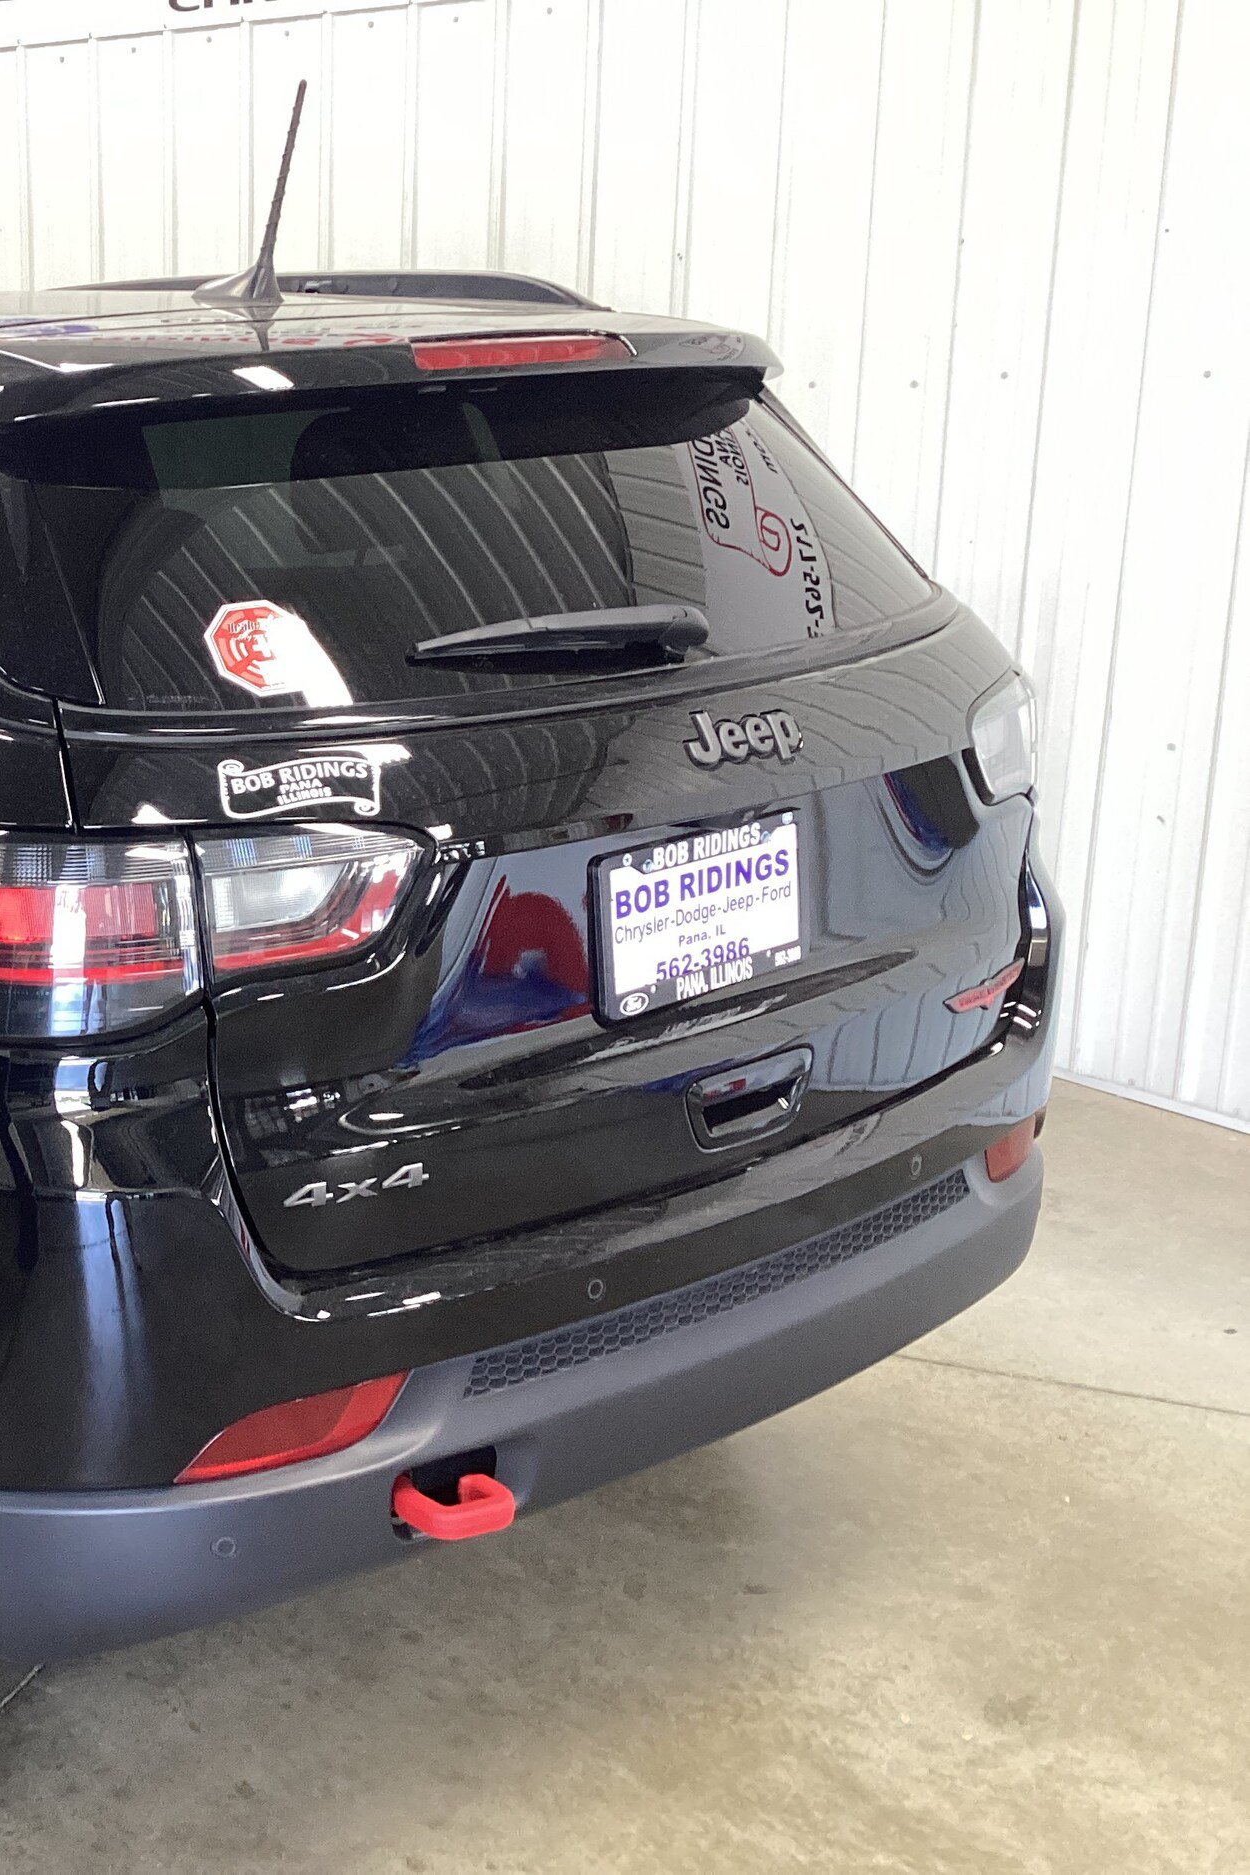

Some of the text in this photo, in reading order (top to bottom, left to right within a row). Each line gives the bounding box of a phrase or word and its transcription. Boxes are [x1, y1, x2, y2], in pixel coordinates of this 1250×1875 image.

[683, 709, 803, 771] Jeep
[231, 761, 369, 795] BOB RIDINGS
[277, 786, 332, 805] ILLINOIS
[279, 778, 322, 794] PANA
[653, 822, 761, 871] BOB RIDINGS
[615, 849, 789, 919] BOB RIDINGS
[615, 881, 792, 944] Chrysler-Dodge-Jeep-Ford
[716, 924, 726, 936] IL
[656, 937, 750, 982] 562-3986
[710, 956, 753, 990] ILLINOIS
[283, 1162, 430, 1207] 4x4
